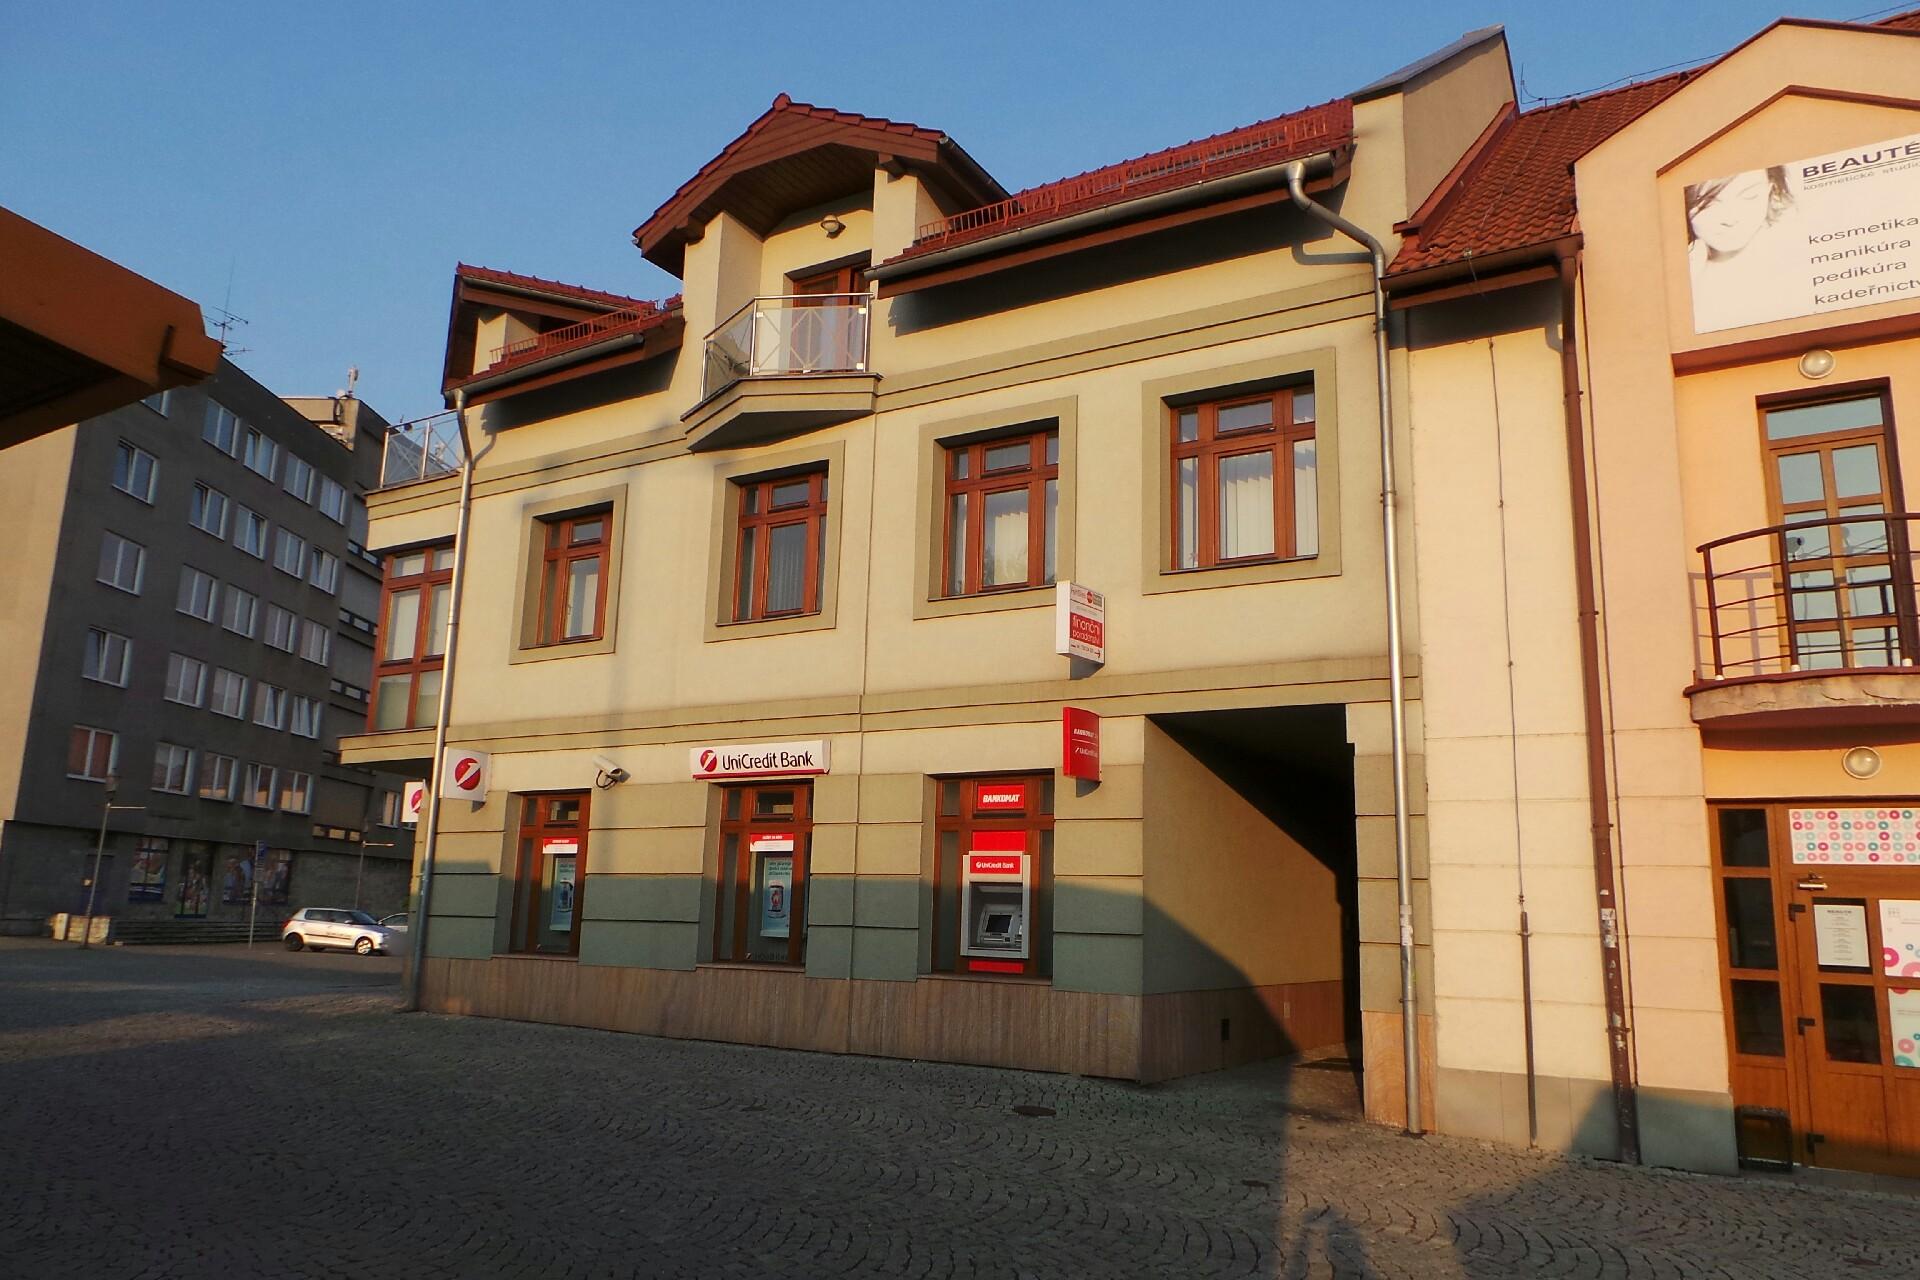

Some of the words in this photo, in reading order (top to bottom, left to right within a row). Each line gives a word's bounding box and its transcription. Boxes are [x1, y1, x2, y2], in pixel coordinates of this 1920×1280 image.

[1802, 141, 1920, 178] BEAUTÉ
[1808, 216, 1920, 245] kosmetika
[1810, 239, 1912, 265] manikúra
[1812, 261, 1907, 287] pedikúra
[722, 752, 778, 771] UniCredit
[780, 750, 814, 768] Bank
[982, 794, 1020, 803] BANKOMAT
